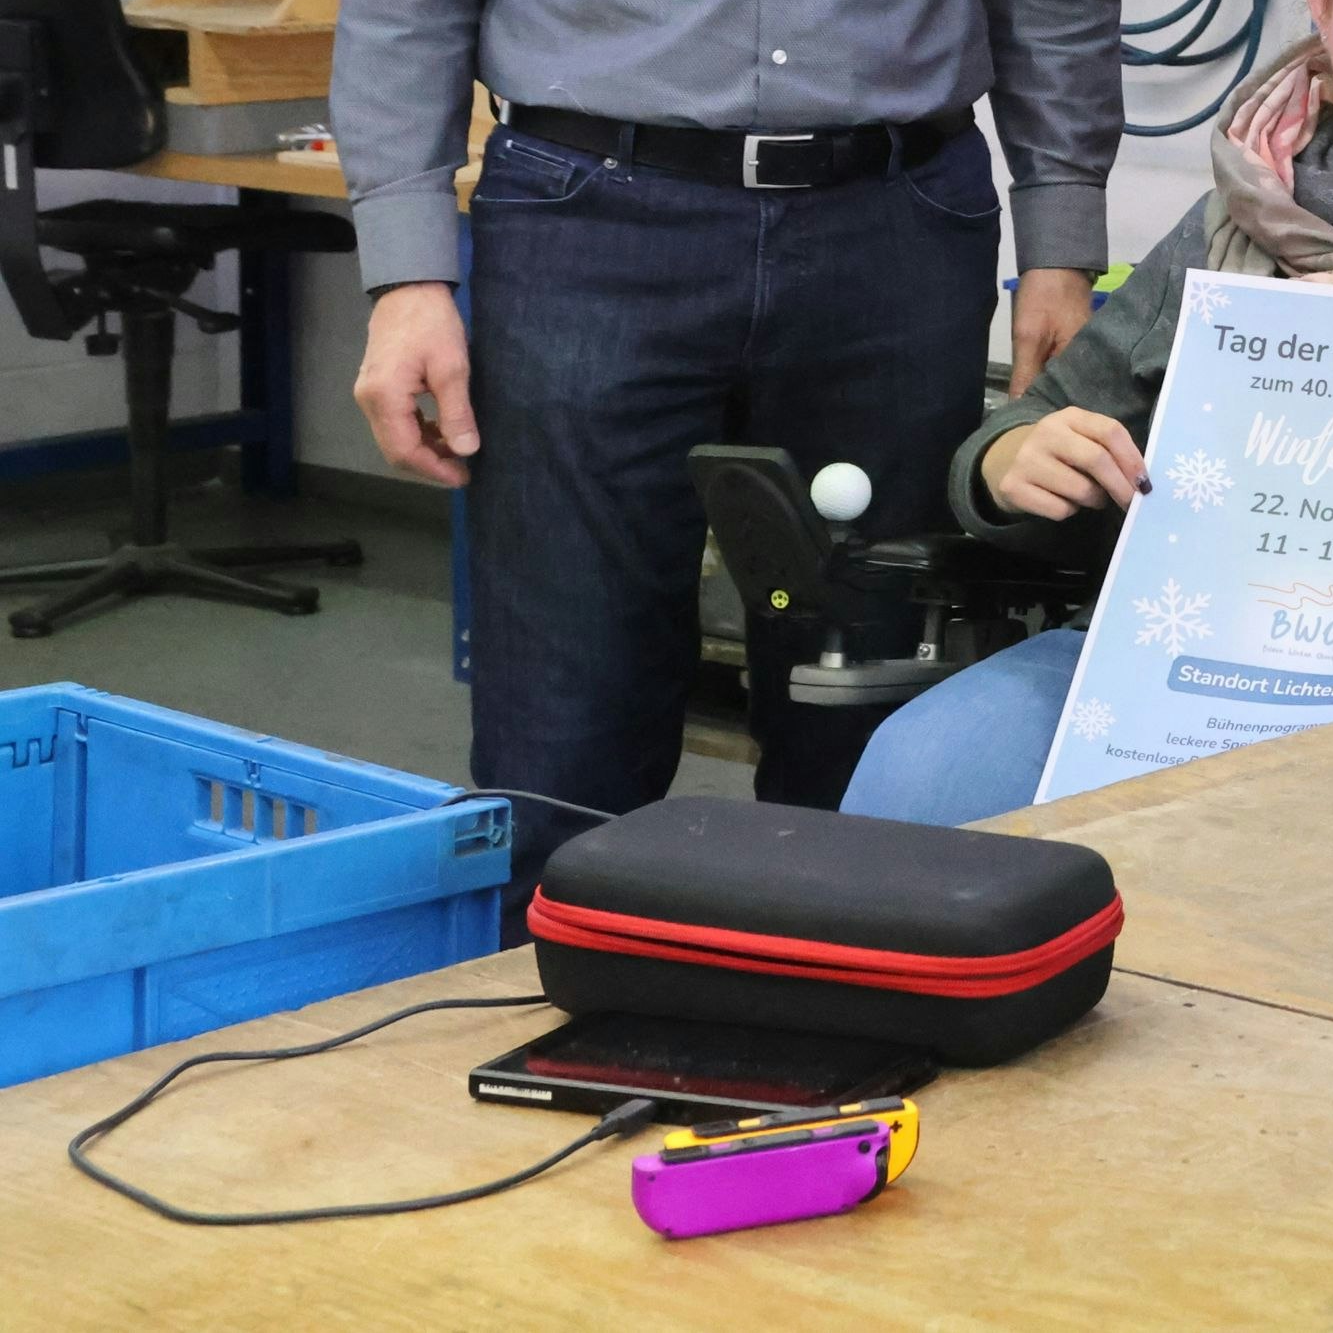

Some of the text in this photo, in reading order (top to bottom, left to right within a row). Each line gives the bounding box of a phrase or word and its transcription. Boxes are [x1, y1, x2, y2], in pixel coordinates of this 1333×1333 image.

[1214, 325, 1267, 361] Tag
[1278, 334, 1329, 362] der
[1250, 377, 1293, 393] zum
[1301, 379, 1331, 397] 40.
[1251, 493, 1288, 516] 22.
[1256, 533, 1287, 554] 11
[1178, 665, 1269, 693] Standort
[1166, 732, 1217, 749] leckere
[1105, 744, 1184, 767] kostenlose
